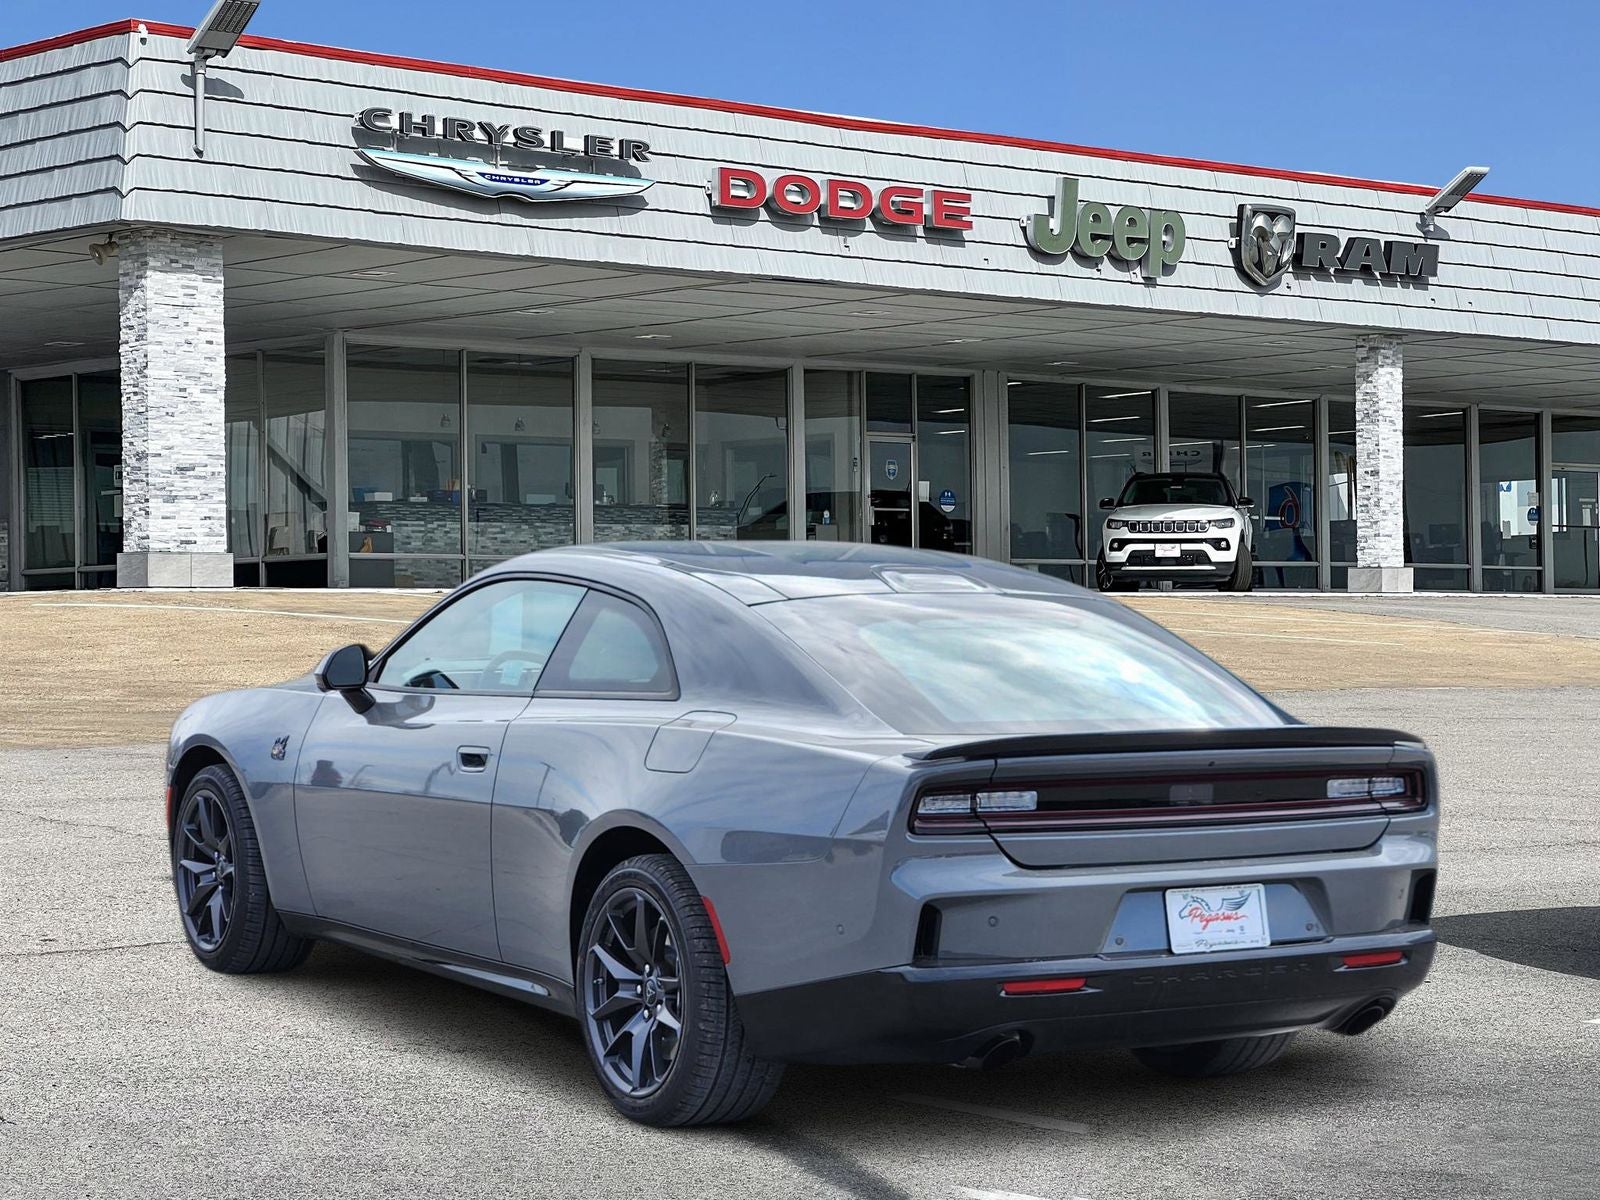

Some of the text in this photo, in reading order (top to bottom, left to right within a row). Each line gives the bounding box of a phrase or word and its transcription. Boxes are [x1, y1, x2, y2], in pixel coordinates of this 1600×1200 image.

[357, 106, 651, 163] CHRYSLER
[484, 174, 541, 185] CHRYSLER
[711, 166, 974, 231] DODGE
[1026, 176, 1187, 279] Jeep
[1299, 231, 1441, 278] RAM
[1187, 906, 1249, 931] Pegasus
